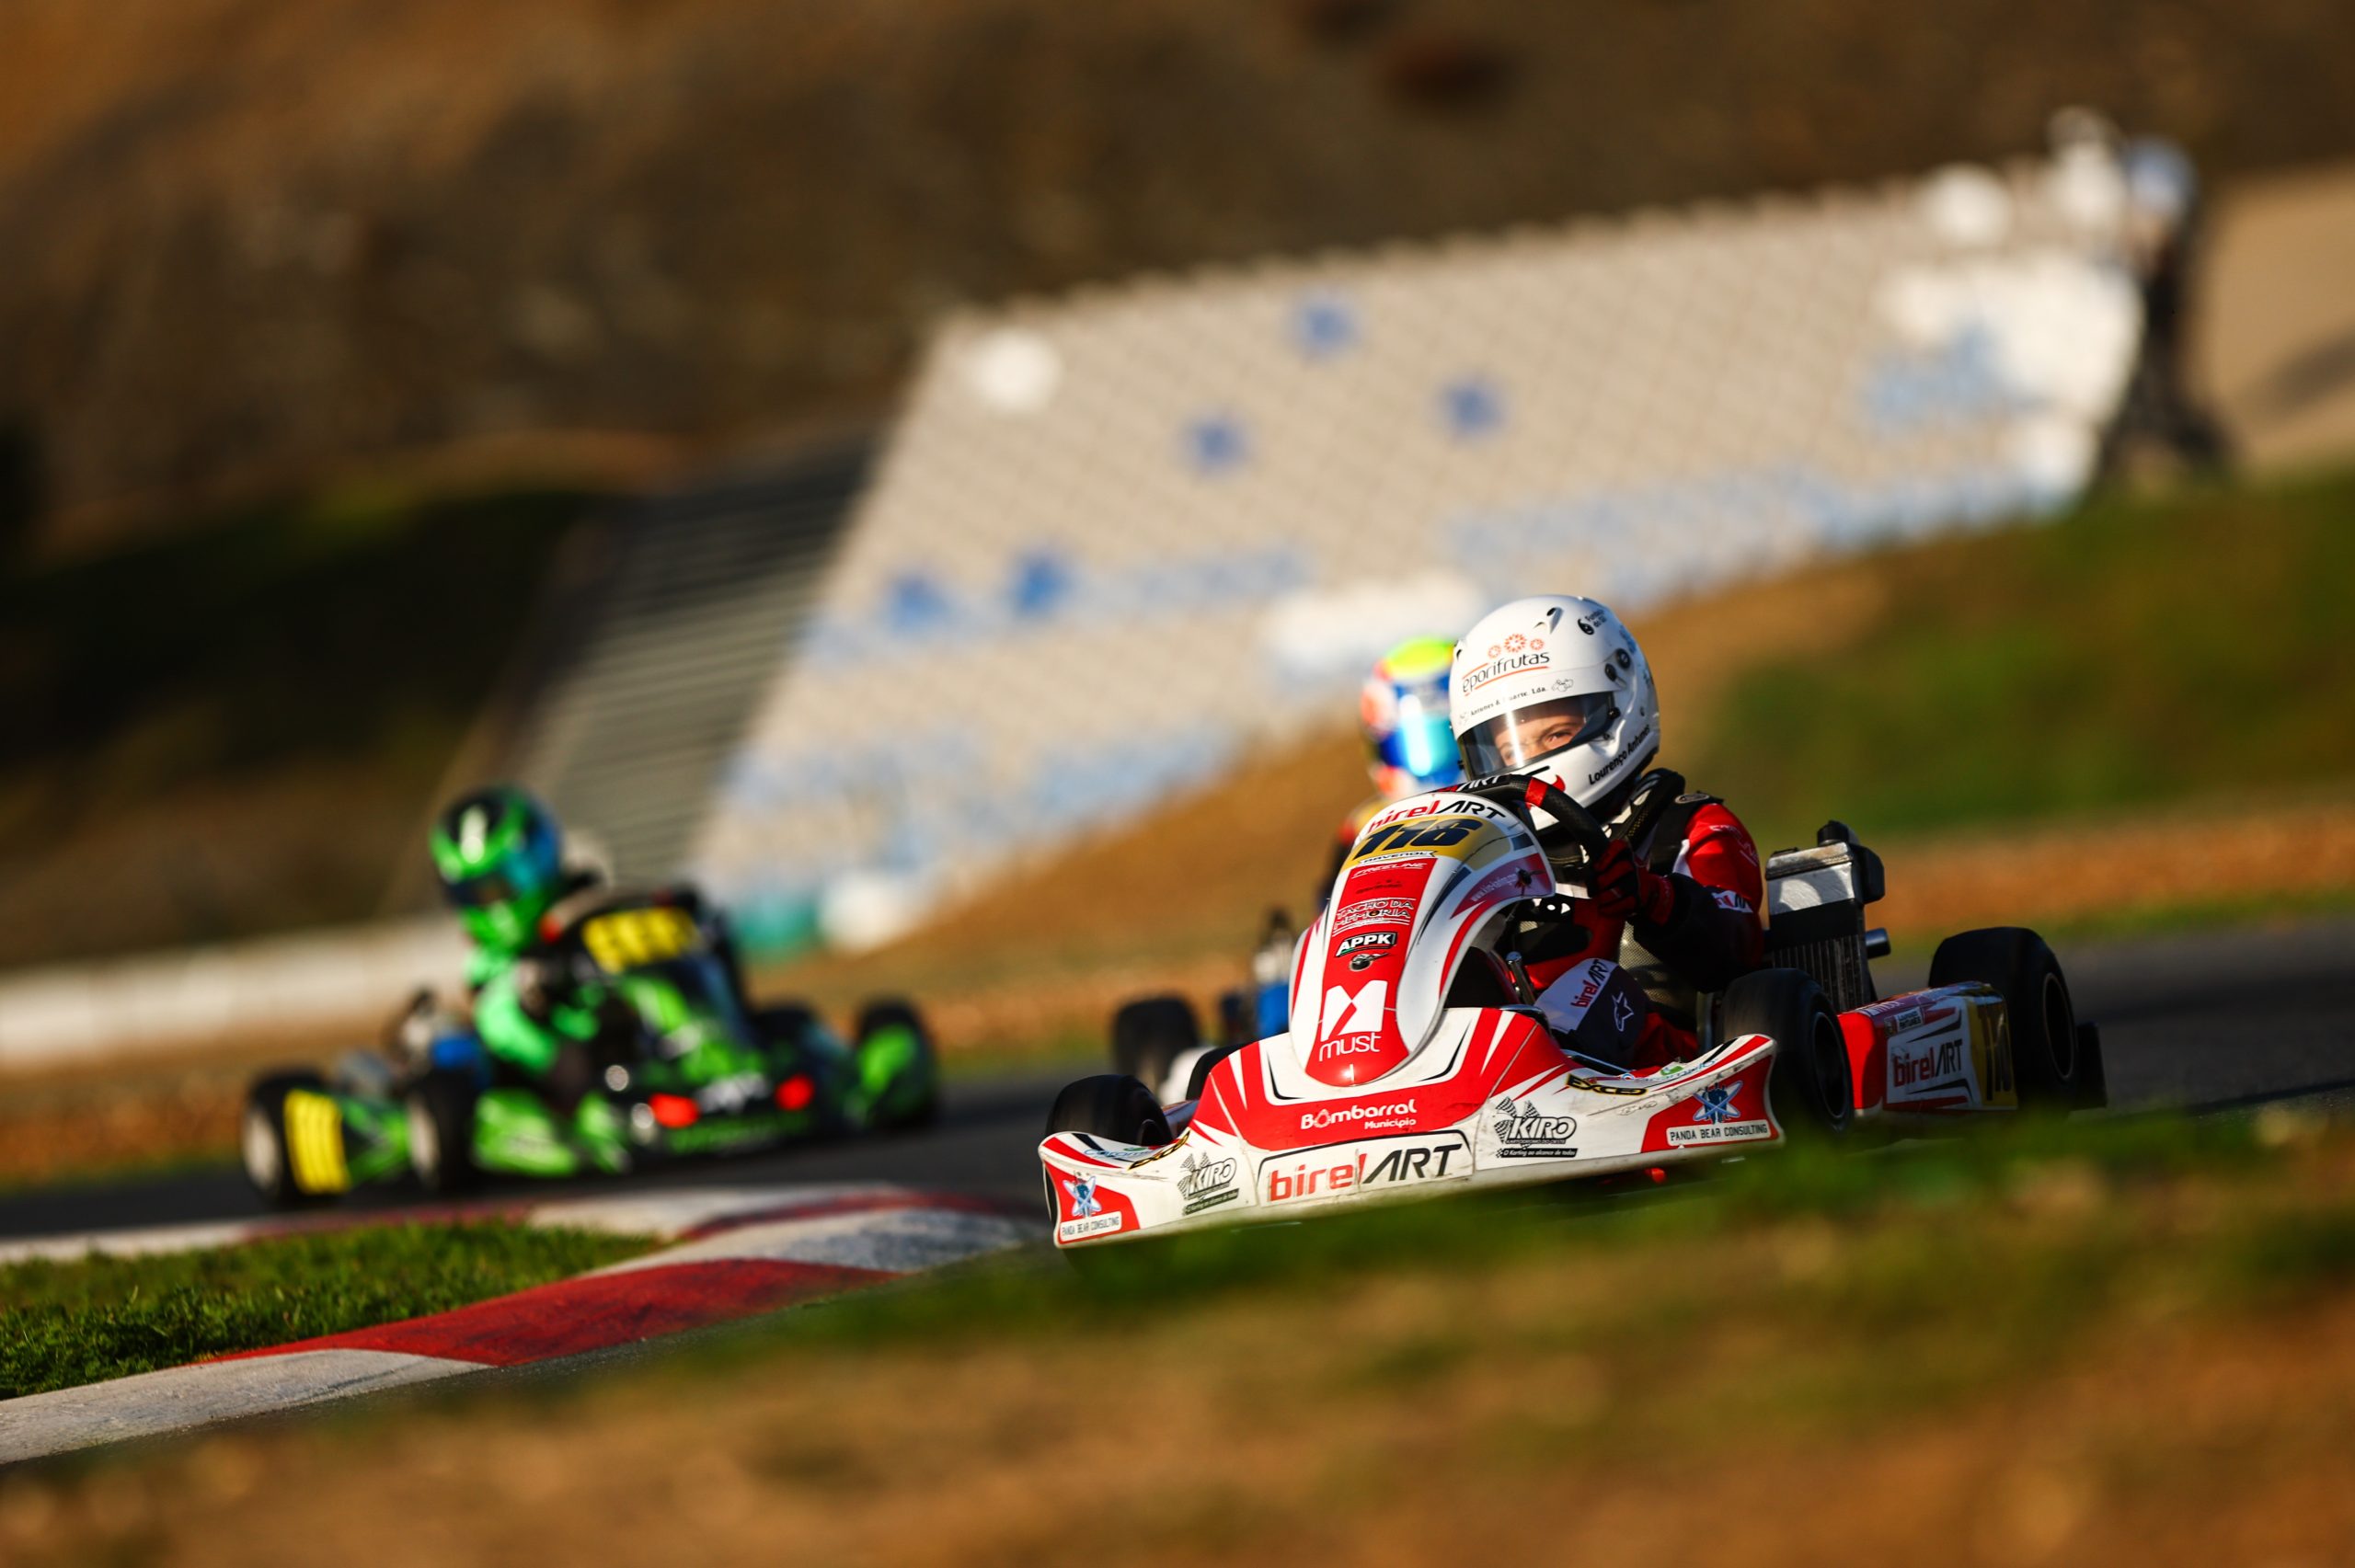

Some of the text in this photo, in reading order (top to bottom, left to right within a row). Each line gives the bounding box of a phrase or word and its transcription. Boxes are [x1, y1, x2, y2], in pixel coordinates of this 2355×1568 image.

[1589, 750, 1627, 784] Lourenço
[1353, 818, 1483, 860] 116
[1363, 852, 1427, 863] RAVENOL
[1390, 899, 1414, 910] DA
[1336, 933, 1391, 956] APPK
[1318, 1032, 1381, 1061] must
[1301, 1099, 1417, 1129] Bombarral
[1506, 1116, 1577, 1140] KIRO
[1670, 1124, 1768, 1141] PANDA BEAR CONSULTING
[1186, 1157, 1236, 1197] KIRO
[1269, 1143, 1463, 1202] birelART
[1062, 1215, 1120, 1236] PANDA BEAR CONSULTING
